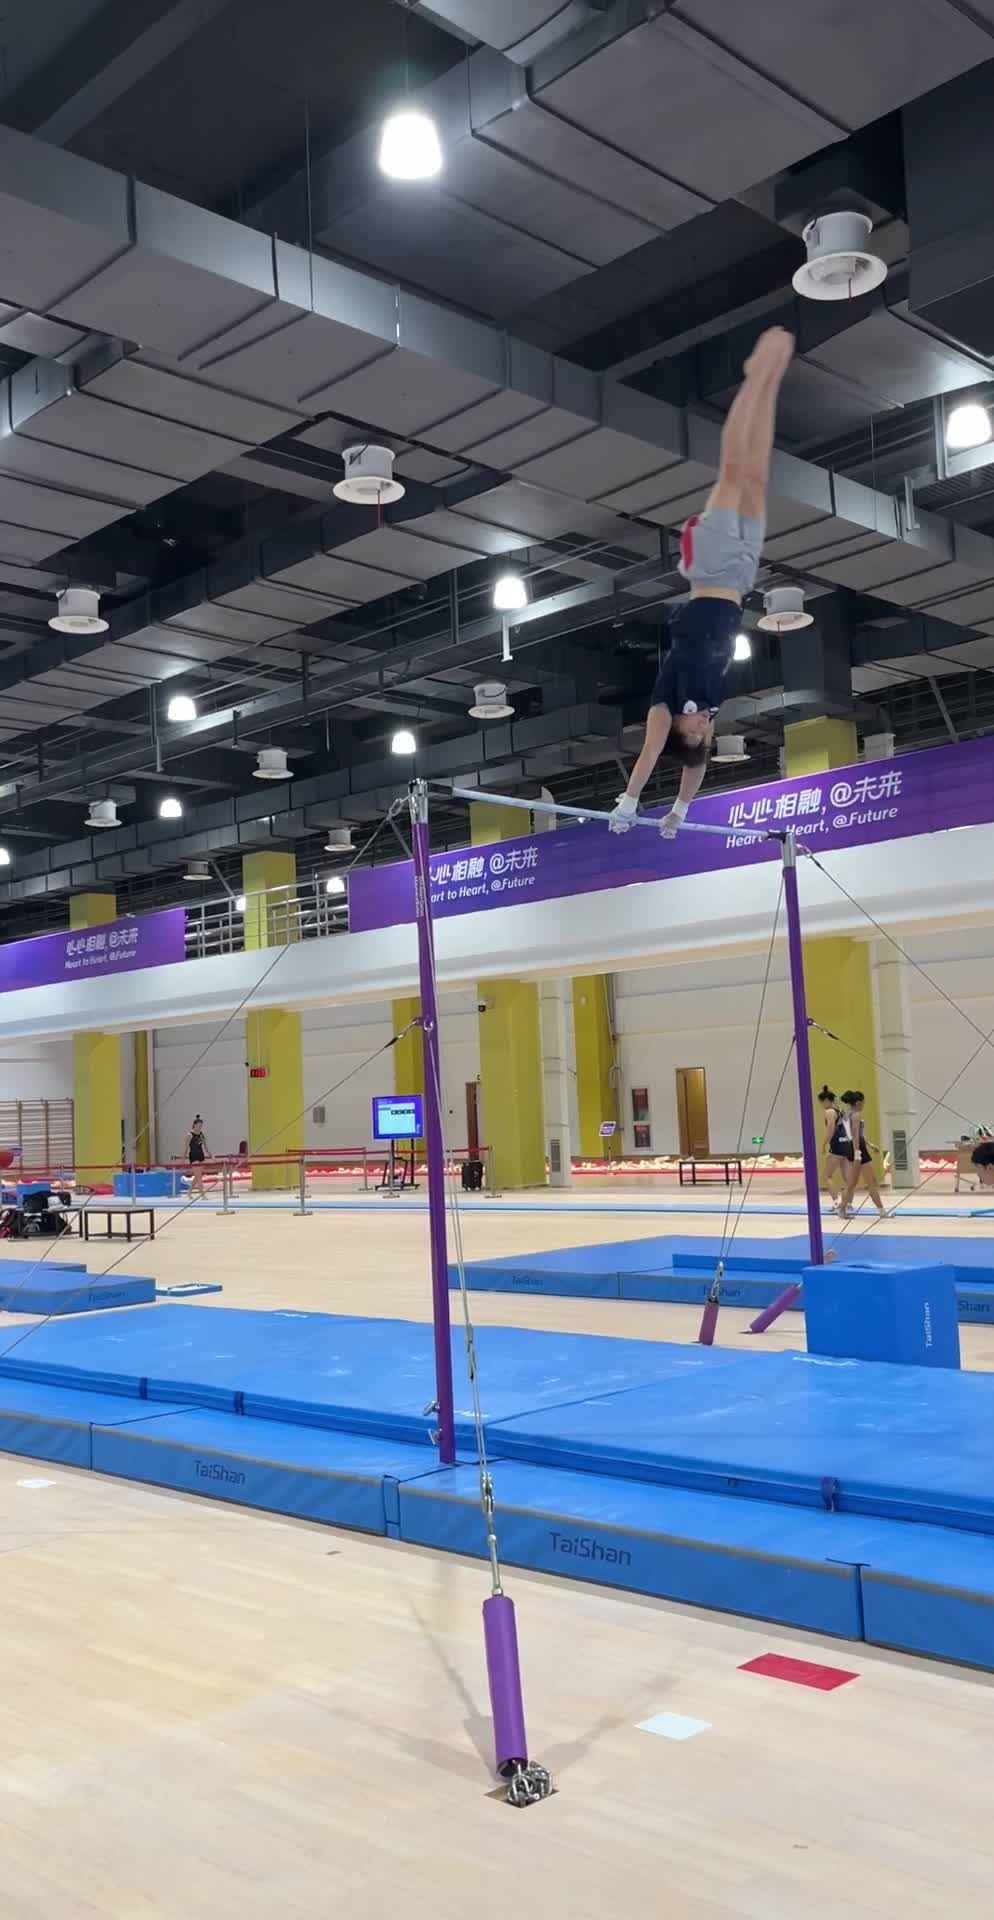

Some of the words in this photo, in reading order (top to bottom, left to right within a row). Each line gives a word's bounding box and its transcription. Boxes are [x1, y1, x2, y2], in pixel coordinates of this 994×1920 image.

[832, 807, 898, 829] @Future
[430, 892, 444, 903] art
[447, 889, 457, 899] to
[459, 883, 489, 897] Heart,
[491, 875, 535, 891] @Future
[959, 1300, 991, 1312] Shan
[194, 1459, 246, 1485] TaiShan
[549, 1531, 632, 1566] TaiShan
